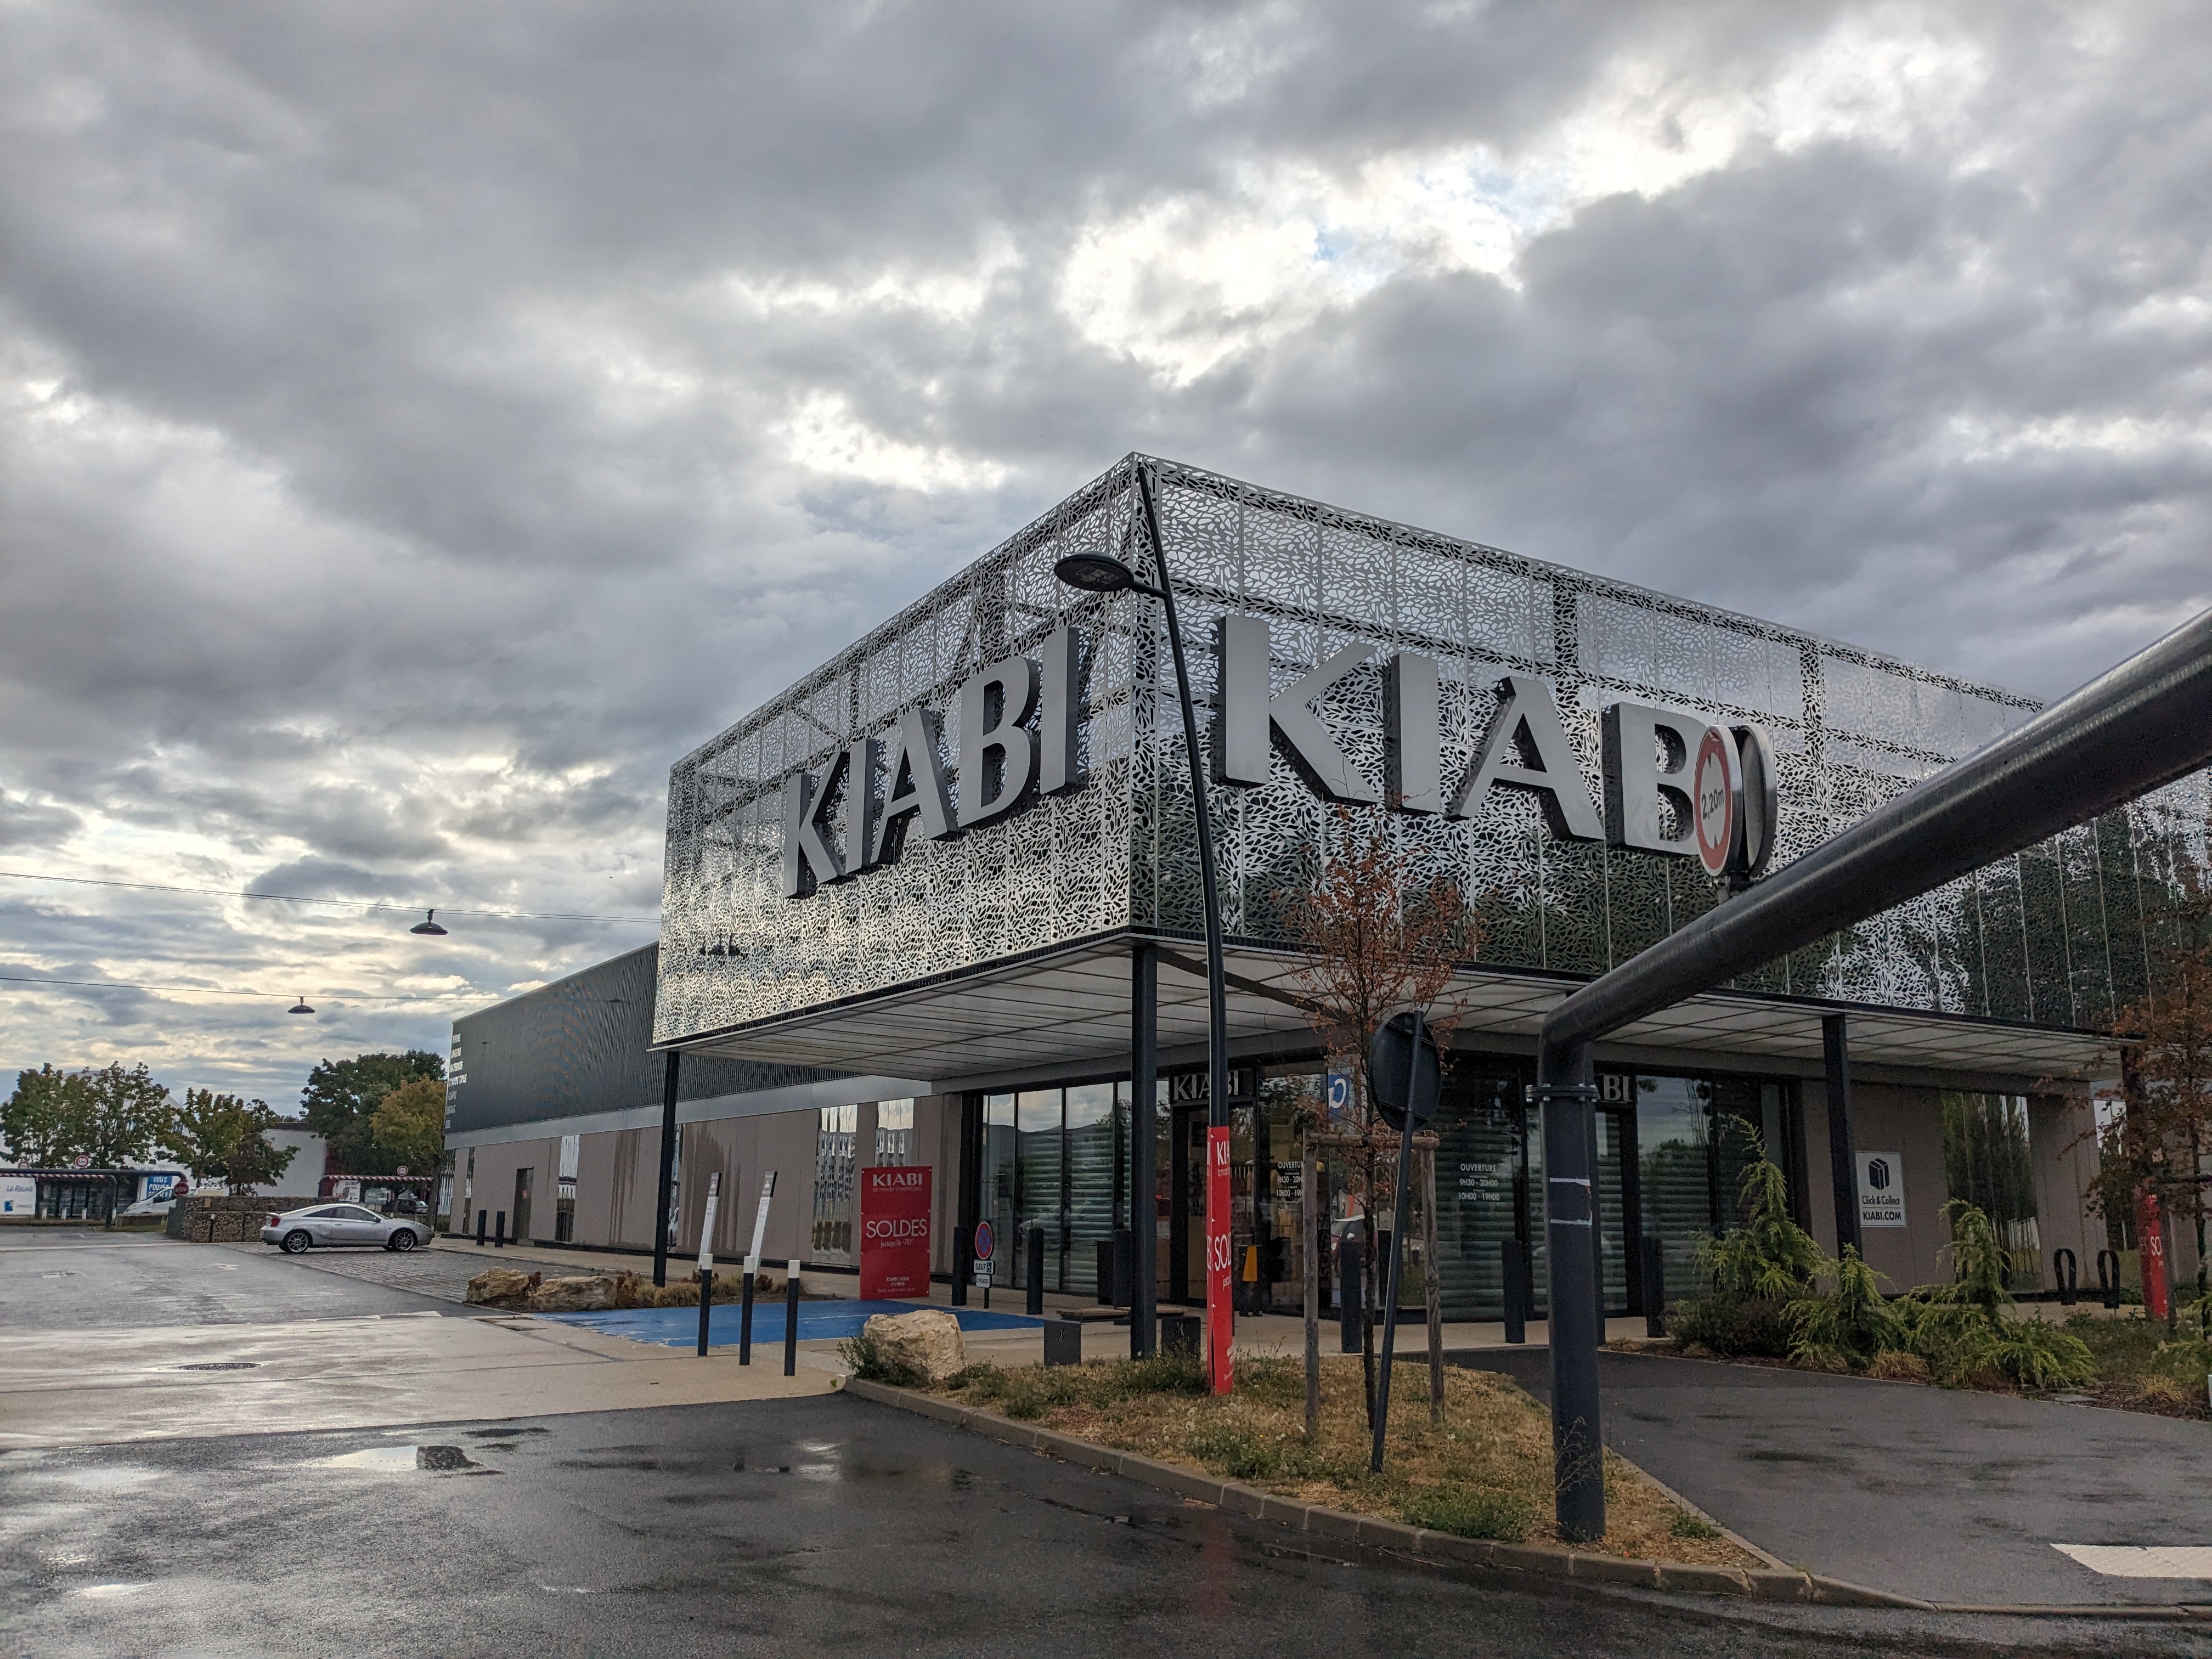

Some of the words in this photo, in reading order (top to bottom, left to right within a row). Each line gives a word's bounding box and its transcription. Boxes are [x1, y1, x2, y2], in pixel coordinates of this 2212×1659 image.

[1209, 613, 1707, 856] KIAB
[784, 626, 1079, 900] KIABI
[1460, 1163, 1496, 1172] OUVERTURE
[873, 1173, 922, 1187] KIABI
[1459, 1192, 1477, 1200] 10H00
[1482, 1193, 1500, 1201] 19H00
[1862, 1195, 1876, 1204] Click
[1876, 1196, 1881, 1204] &
[1881, 1195, 1900, 1205] Collect
[1863, 1211, 1901, 1221] KIABI.COM
[866, 1218, 927, 1238] SOLDES
[975, 1262, 986, 1271] SAUF
